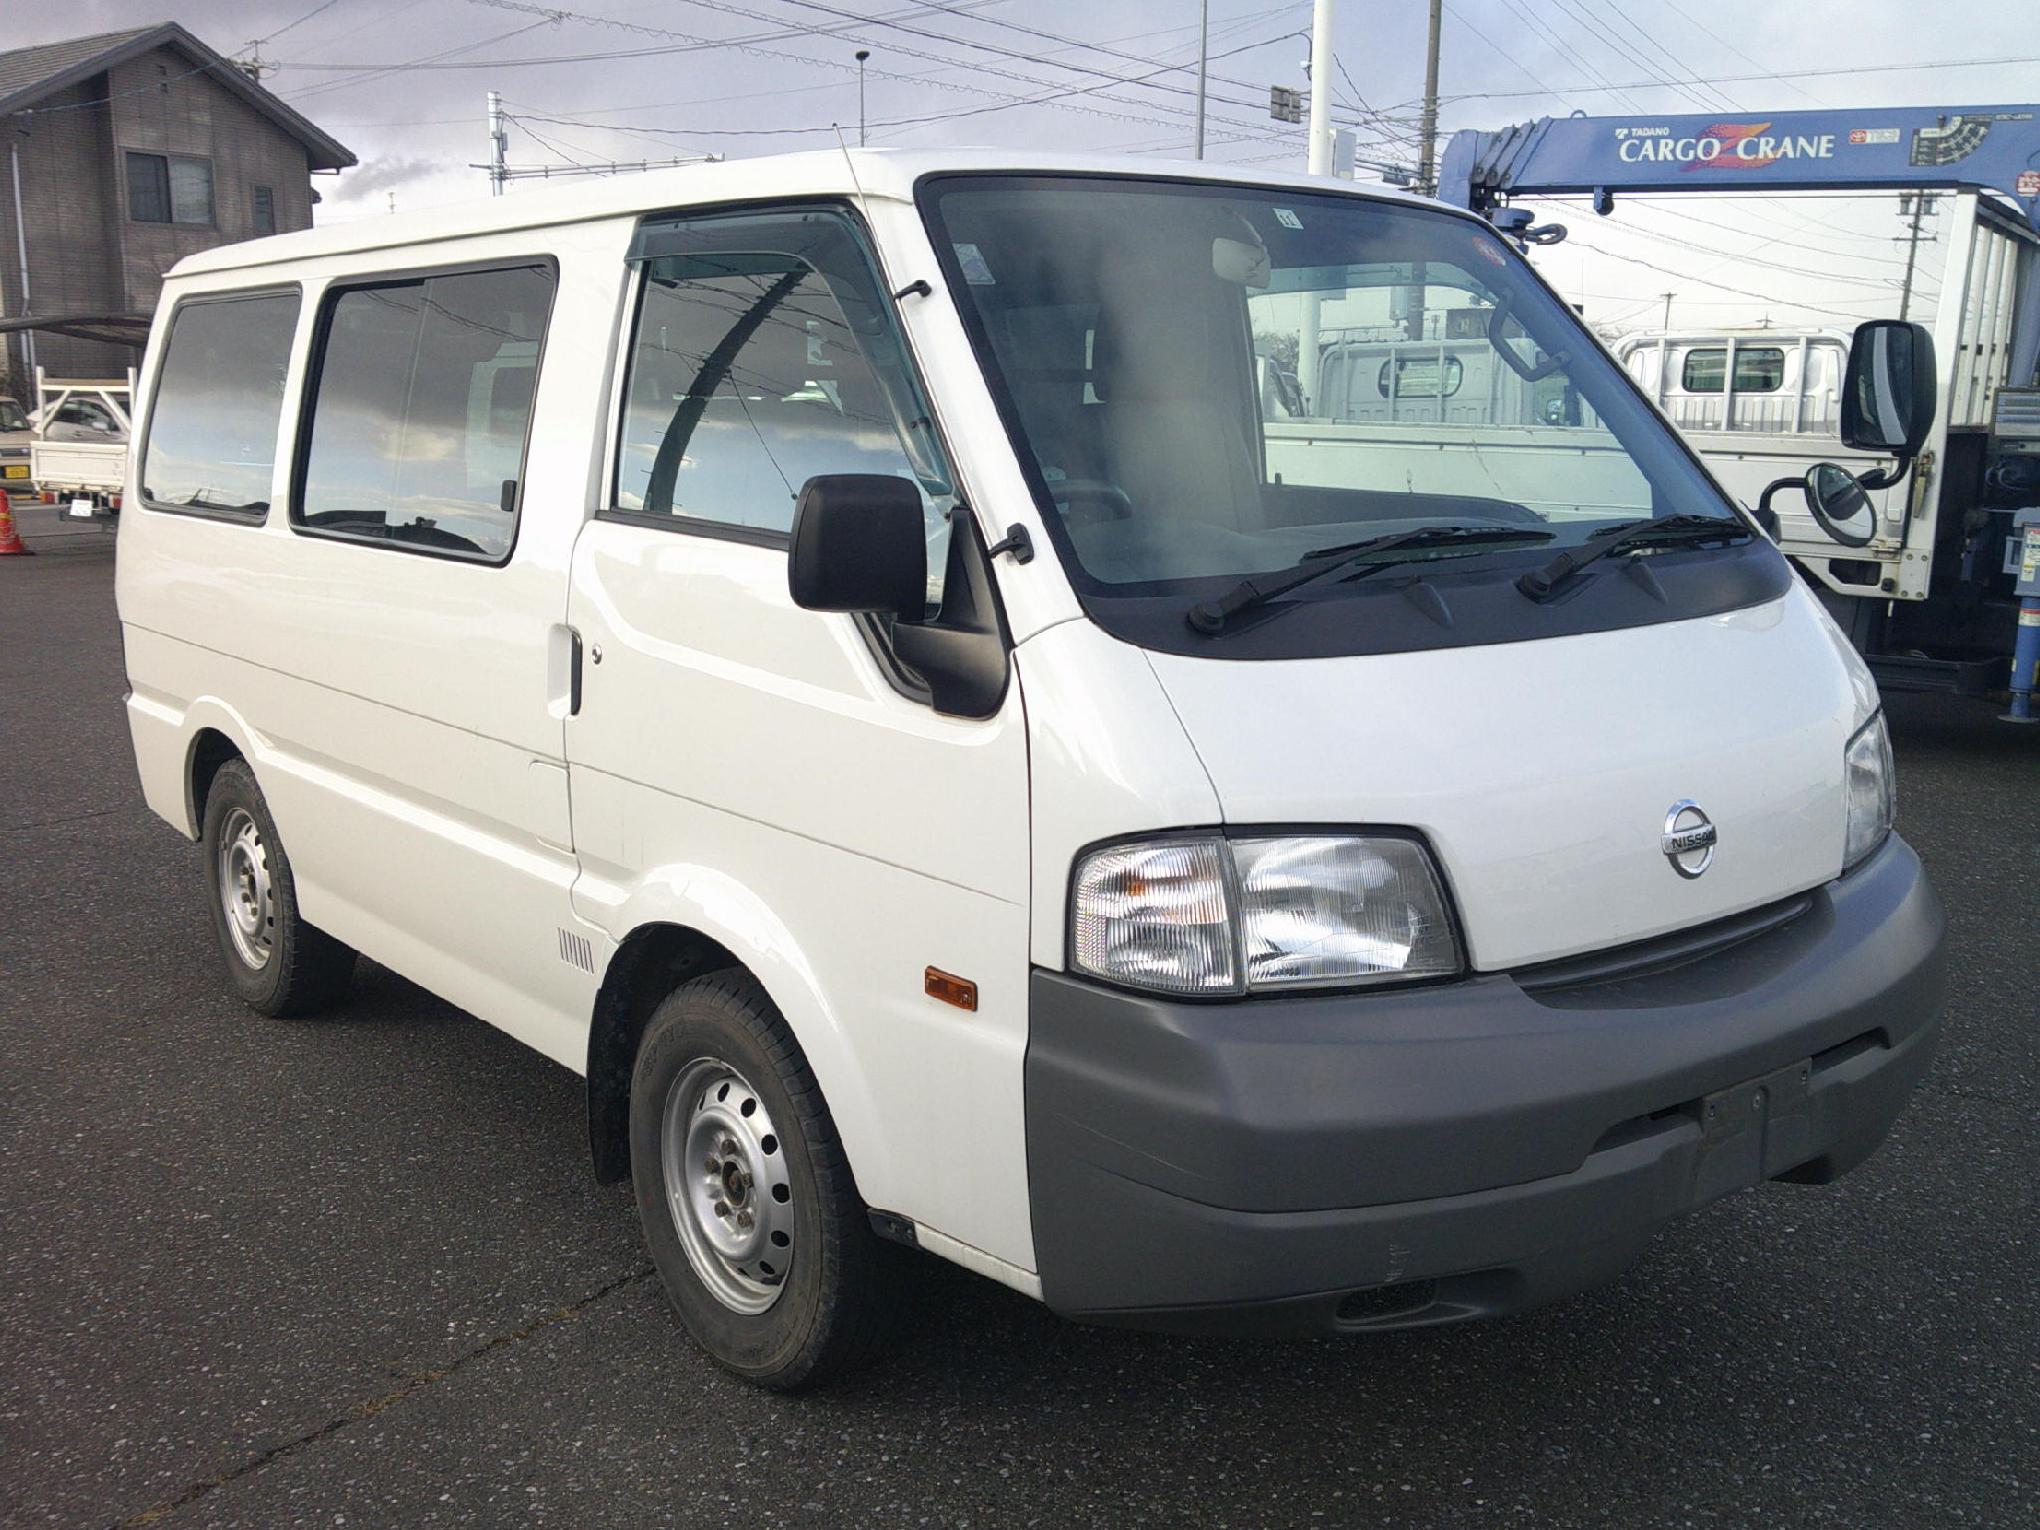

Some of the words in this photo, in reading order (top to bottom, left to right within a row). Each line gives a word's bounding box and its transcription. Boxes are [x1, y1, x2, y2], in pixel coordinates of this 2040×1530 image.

[1631, 127, 1670, 136] TADANO
[1619, 138, 1721, 162] CARGO
[1736, 135, 1836, 159] CRANE
[1671, 829, 1714, 849] NISSAN
